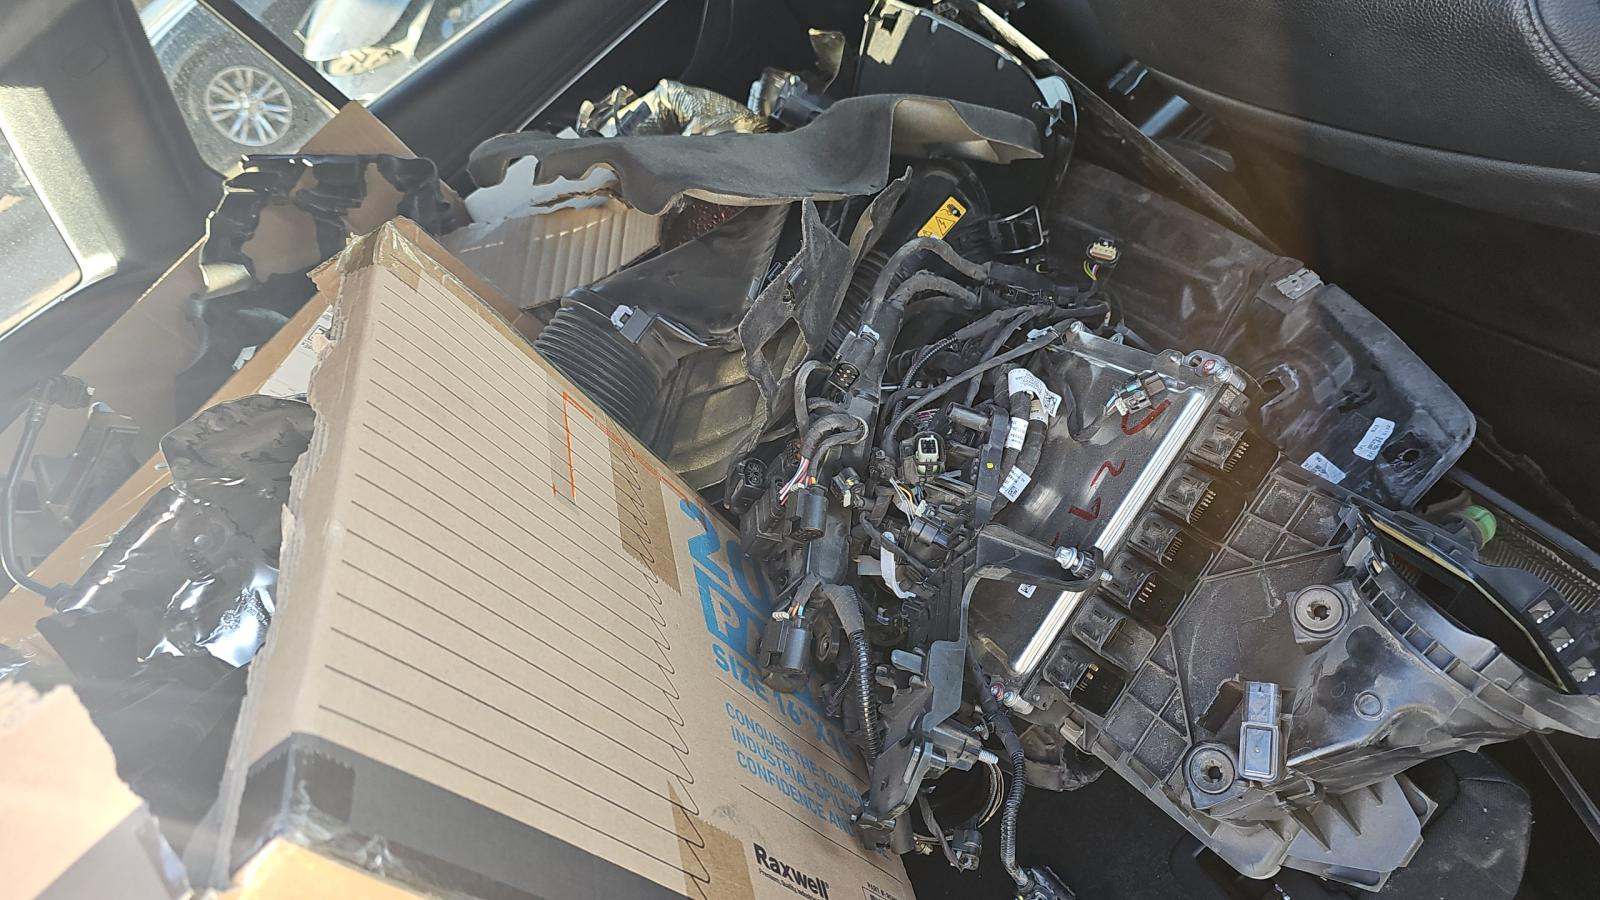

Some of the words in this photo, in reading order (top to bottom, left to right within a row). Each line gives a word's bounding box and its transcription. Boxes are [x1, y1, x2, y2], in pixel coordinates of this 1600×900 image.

[711, 643, 770, 704] SIZE
[726, 702, 793, 759] CONQUER
[730, 724, 814, 792] INDUSTRIAL
[736, 750, 827, 820] CONFIDENCE
[753, 842, 829, 900] Raxwell
